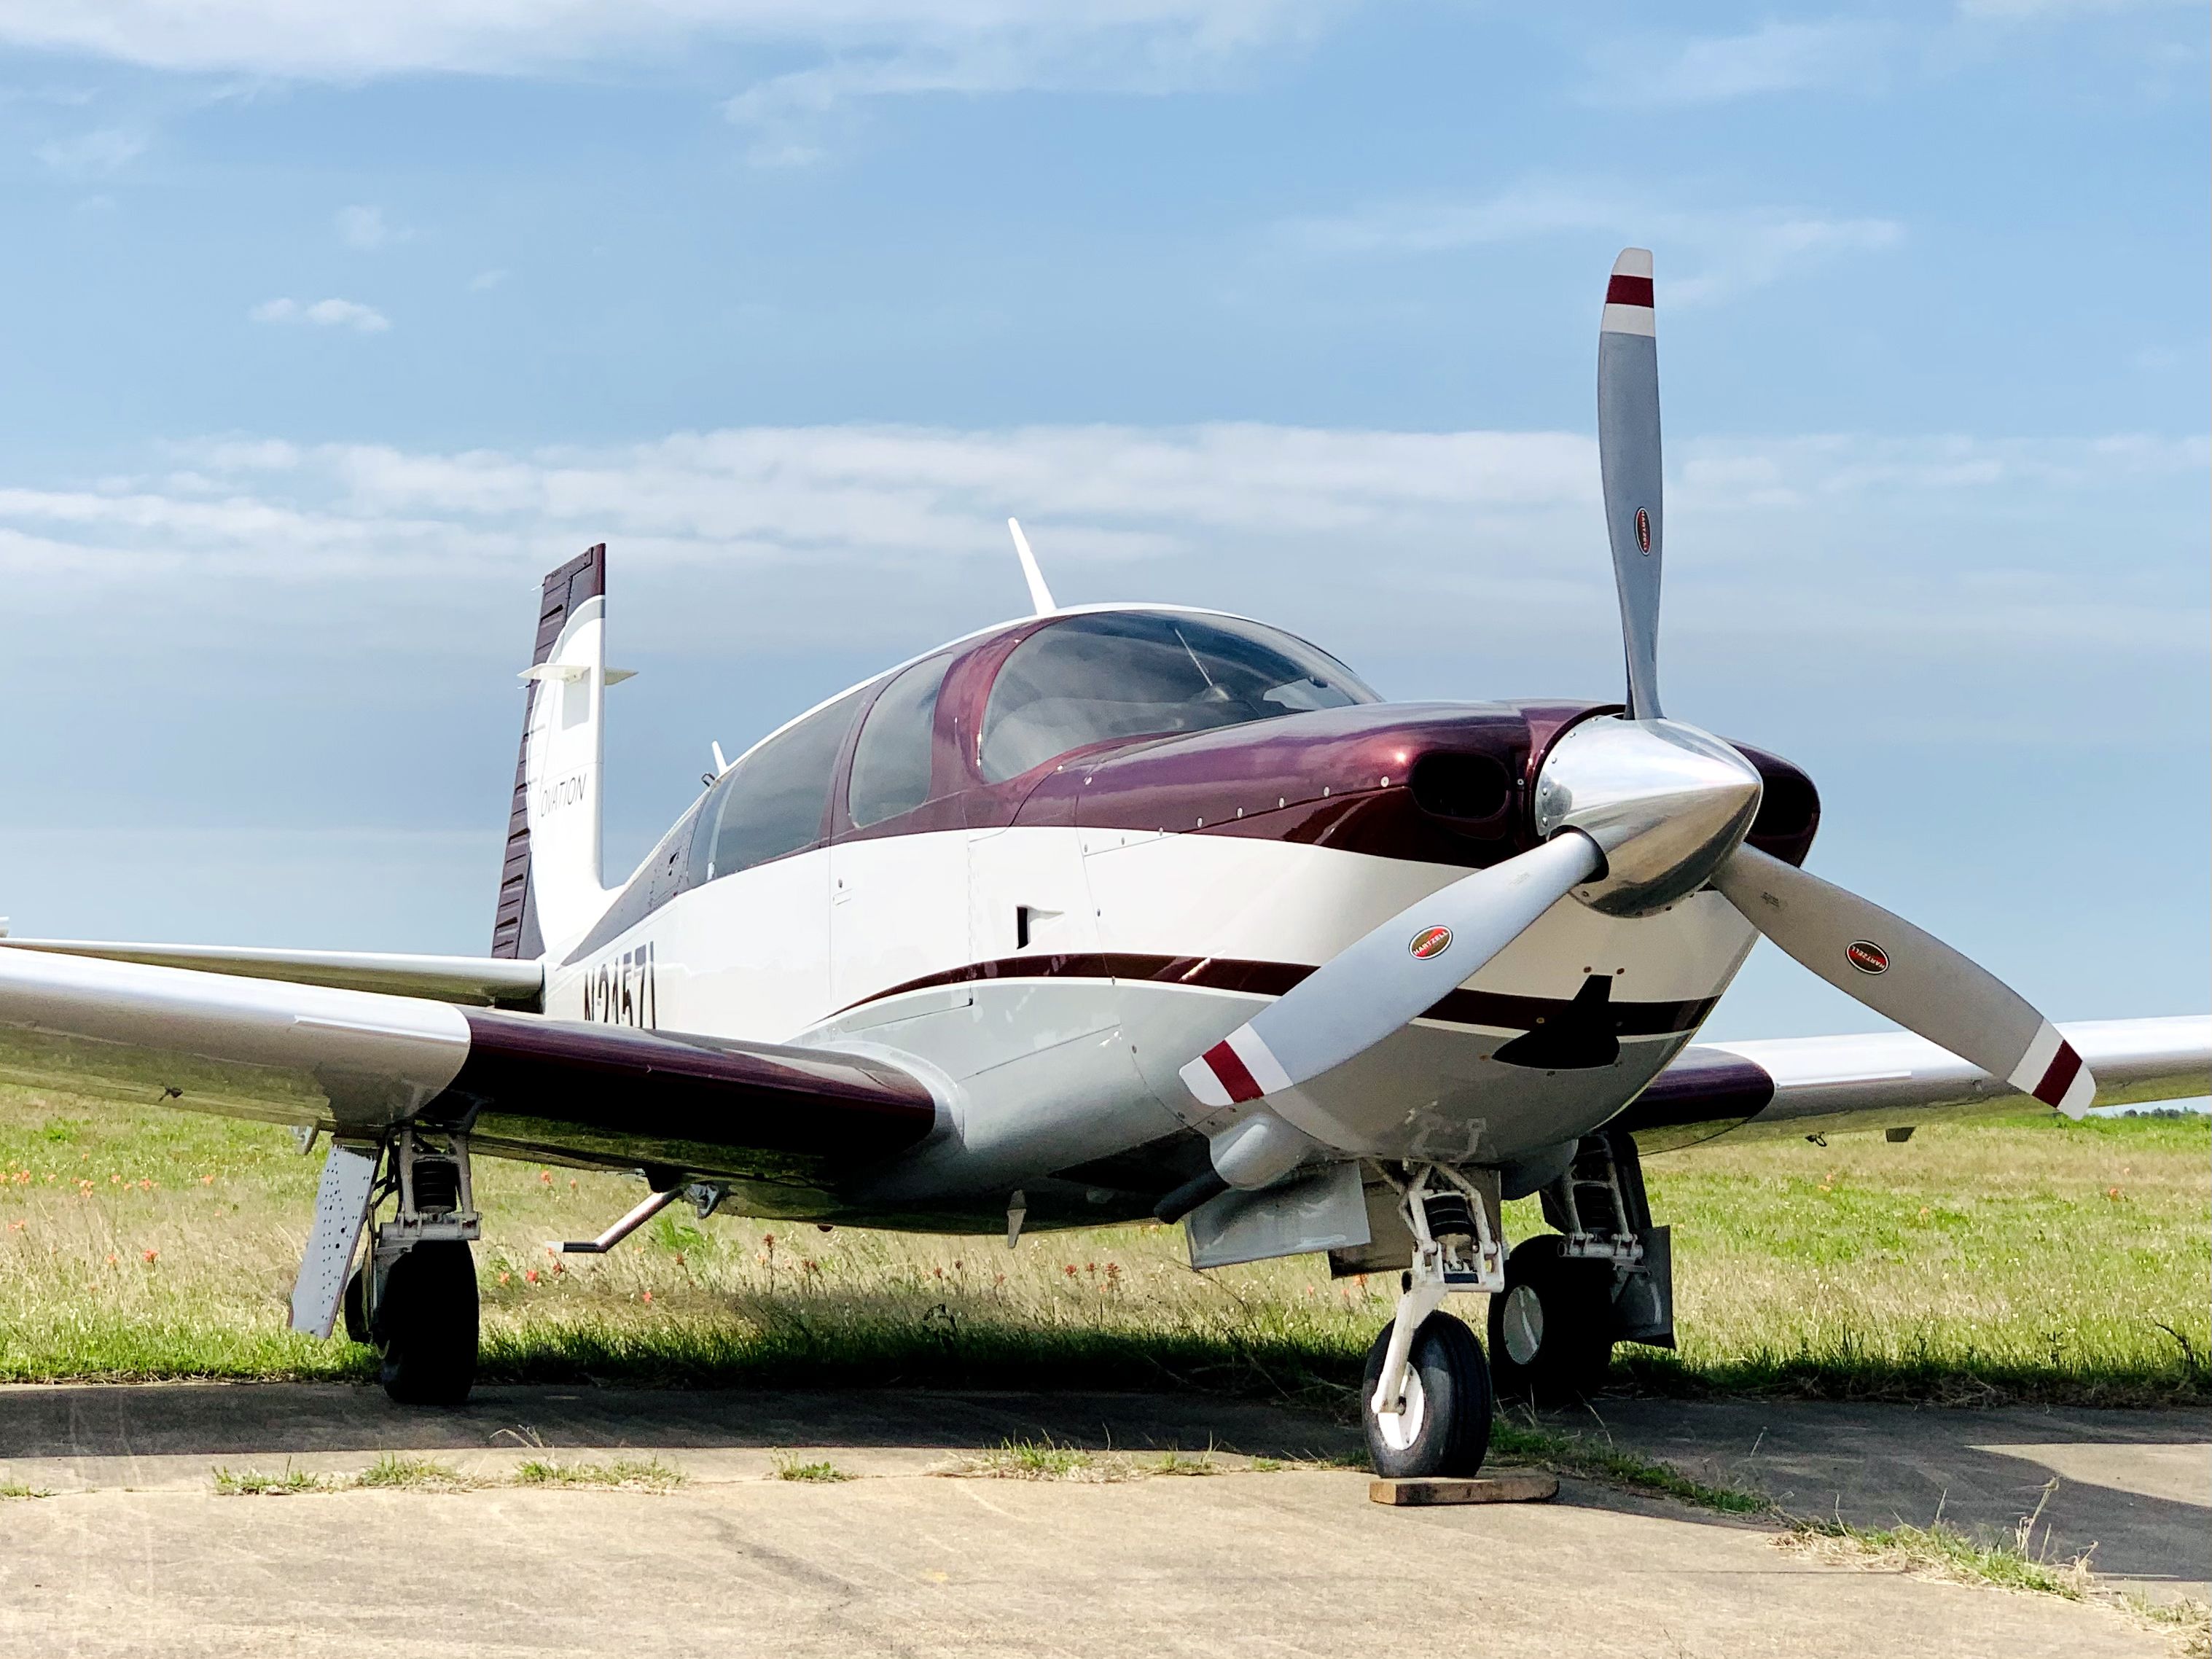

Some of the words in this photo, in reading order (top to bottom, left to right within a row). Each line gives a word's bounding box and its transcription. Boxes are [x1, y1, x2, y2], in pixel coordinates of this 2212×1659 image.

[541, 773, 587, 817] OVATION
[1413, 930, 1449, 956] HARTZELL
[1851, 945, 1885, 969] HARTZELL
